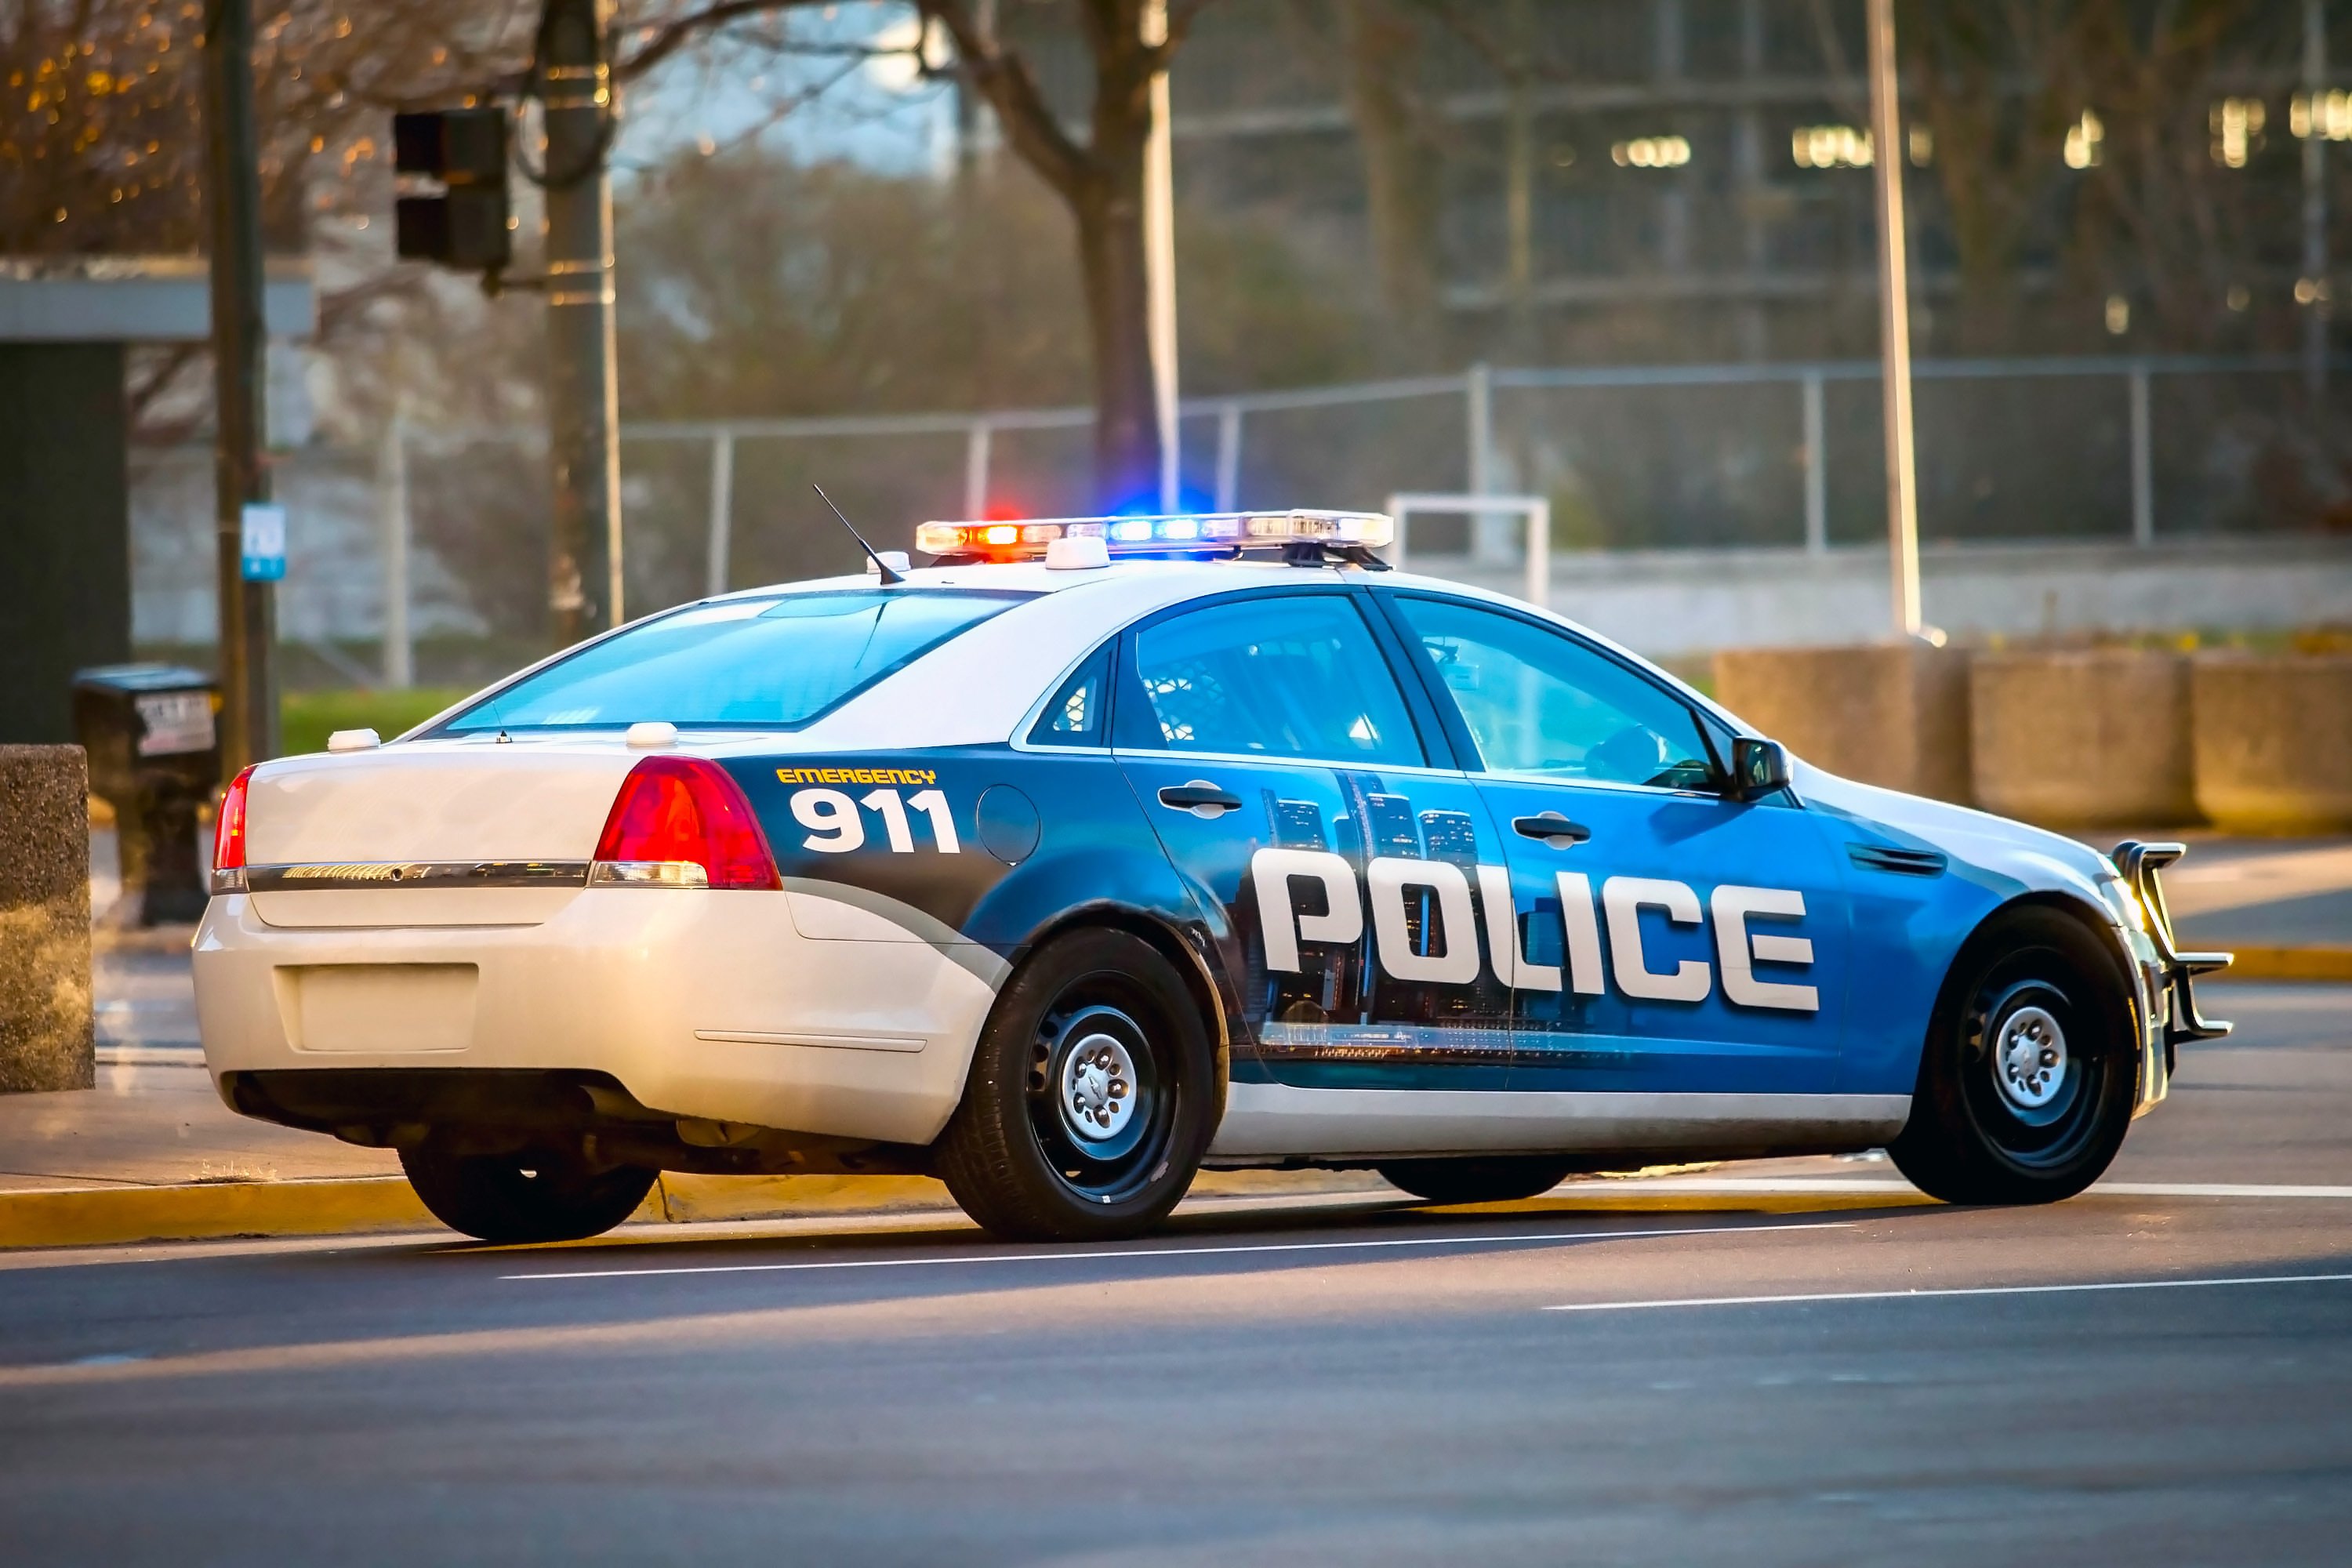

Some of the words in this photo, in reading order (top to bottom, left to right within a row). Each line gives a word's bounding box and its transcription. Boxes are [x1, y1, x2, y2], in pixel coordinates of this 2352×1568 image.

[776, 768, 936, 785] EMERGENCY
[789, 788, 960, 853] 911
[1251, 848, 1819, 1011] POLICE
